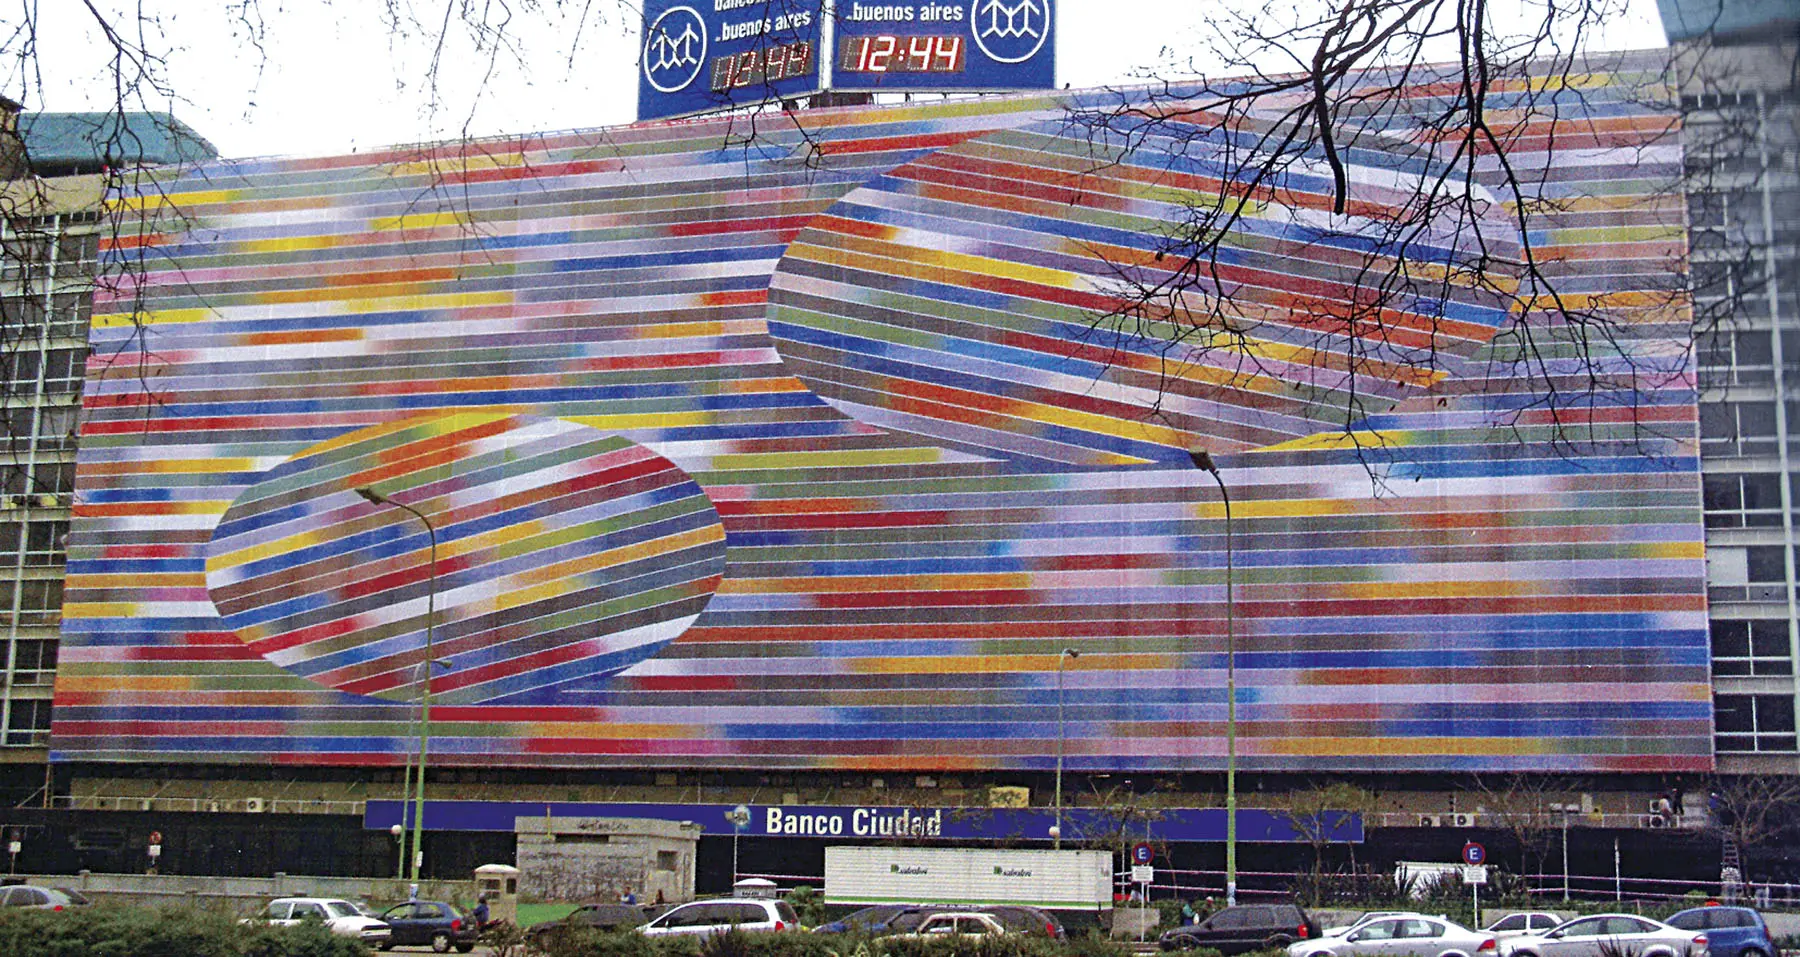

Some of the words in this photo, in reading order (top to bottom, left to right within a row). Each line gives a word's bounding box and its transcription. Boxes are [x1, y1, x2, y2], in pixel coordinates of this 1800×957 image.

[775, 10, 811, 31] aires
[920, 2, 963, 21] aires
[858, 36, 960, 71] 12:44
[766, 807, 843, 835] Banco
[852, 808, 941, 836] Ciudad
[1138, 847, 1147, 860] E
[1469, 847, 1480, 860] E
